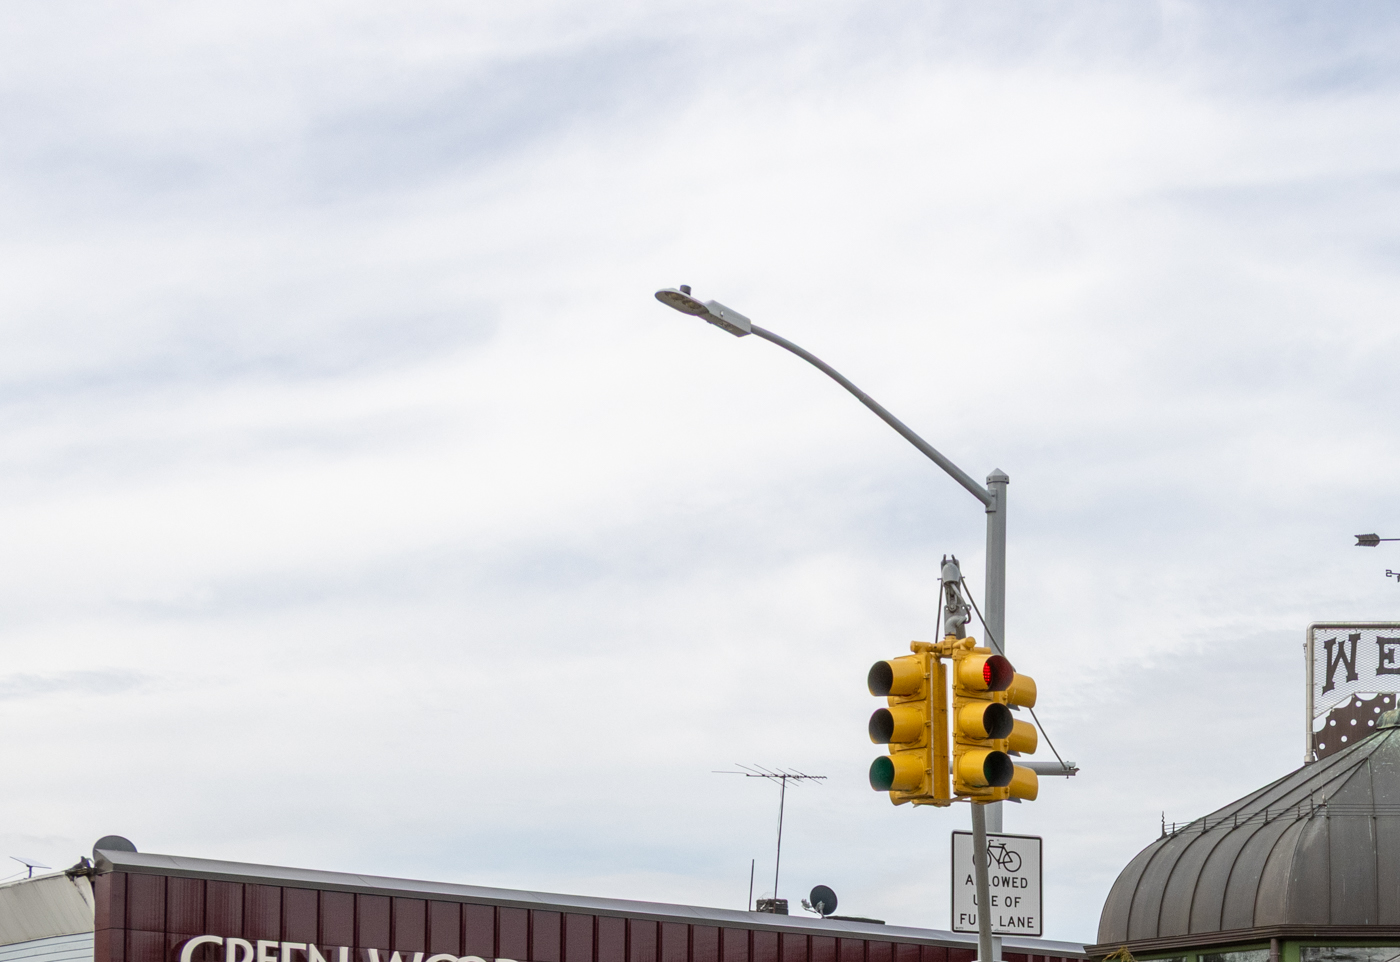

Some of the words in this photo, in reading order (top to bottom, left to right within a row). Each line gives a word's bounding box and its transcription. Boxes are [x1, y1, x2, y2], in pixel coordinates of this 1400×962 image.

[965, 874, 1028, 889] AOWED
[1005, 896, 1021, 908] OF
[1000, 915, 1034, 928] LANE
